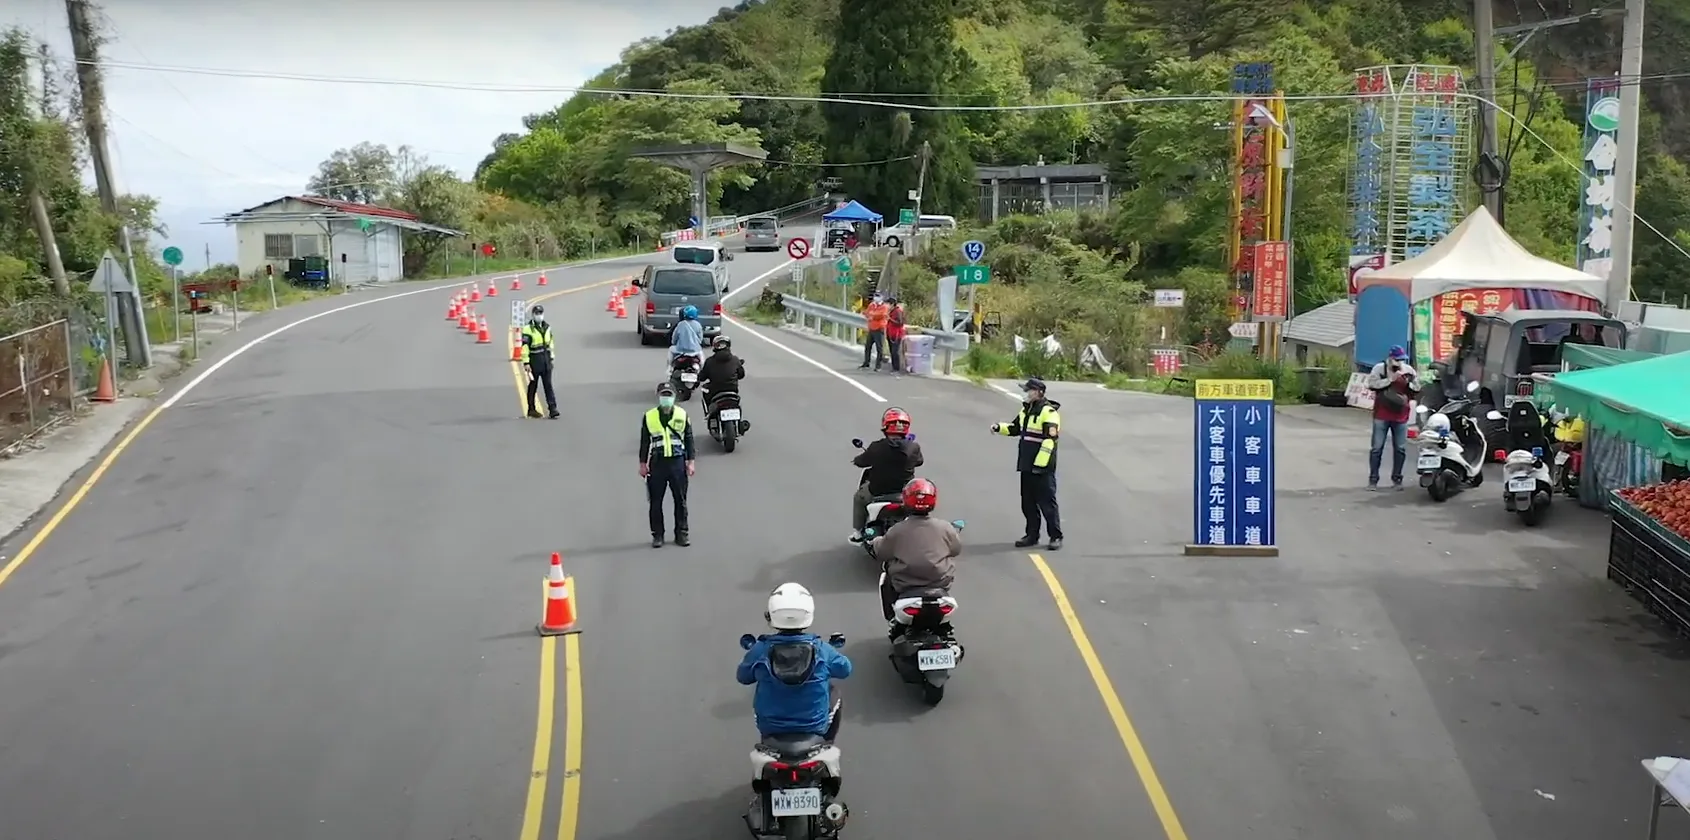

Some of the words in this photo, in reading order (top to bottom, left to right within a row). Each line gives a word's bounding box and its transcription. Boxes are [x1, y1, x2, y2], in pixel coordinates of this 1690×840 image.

[968, 243, 980, 253] 14
[1208, 405, 1226, 545] 大客車優先車道
[1244, 405, 1262, 545] 小客車車道
